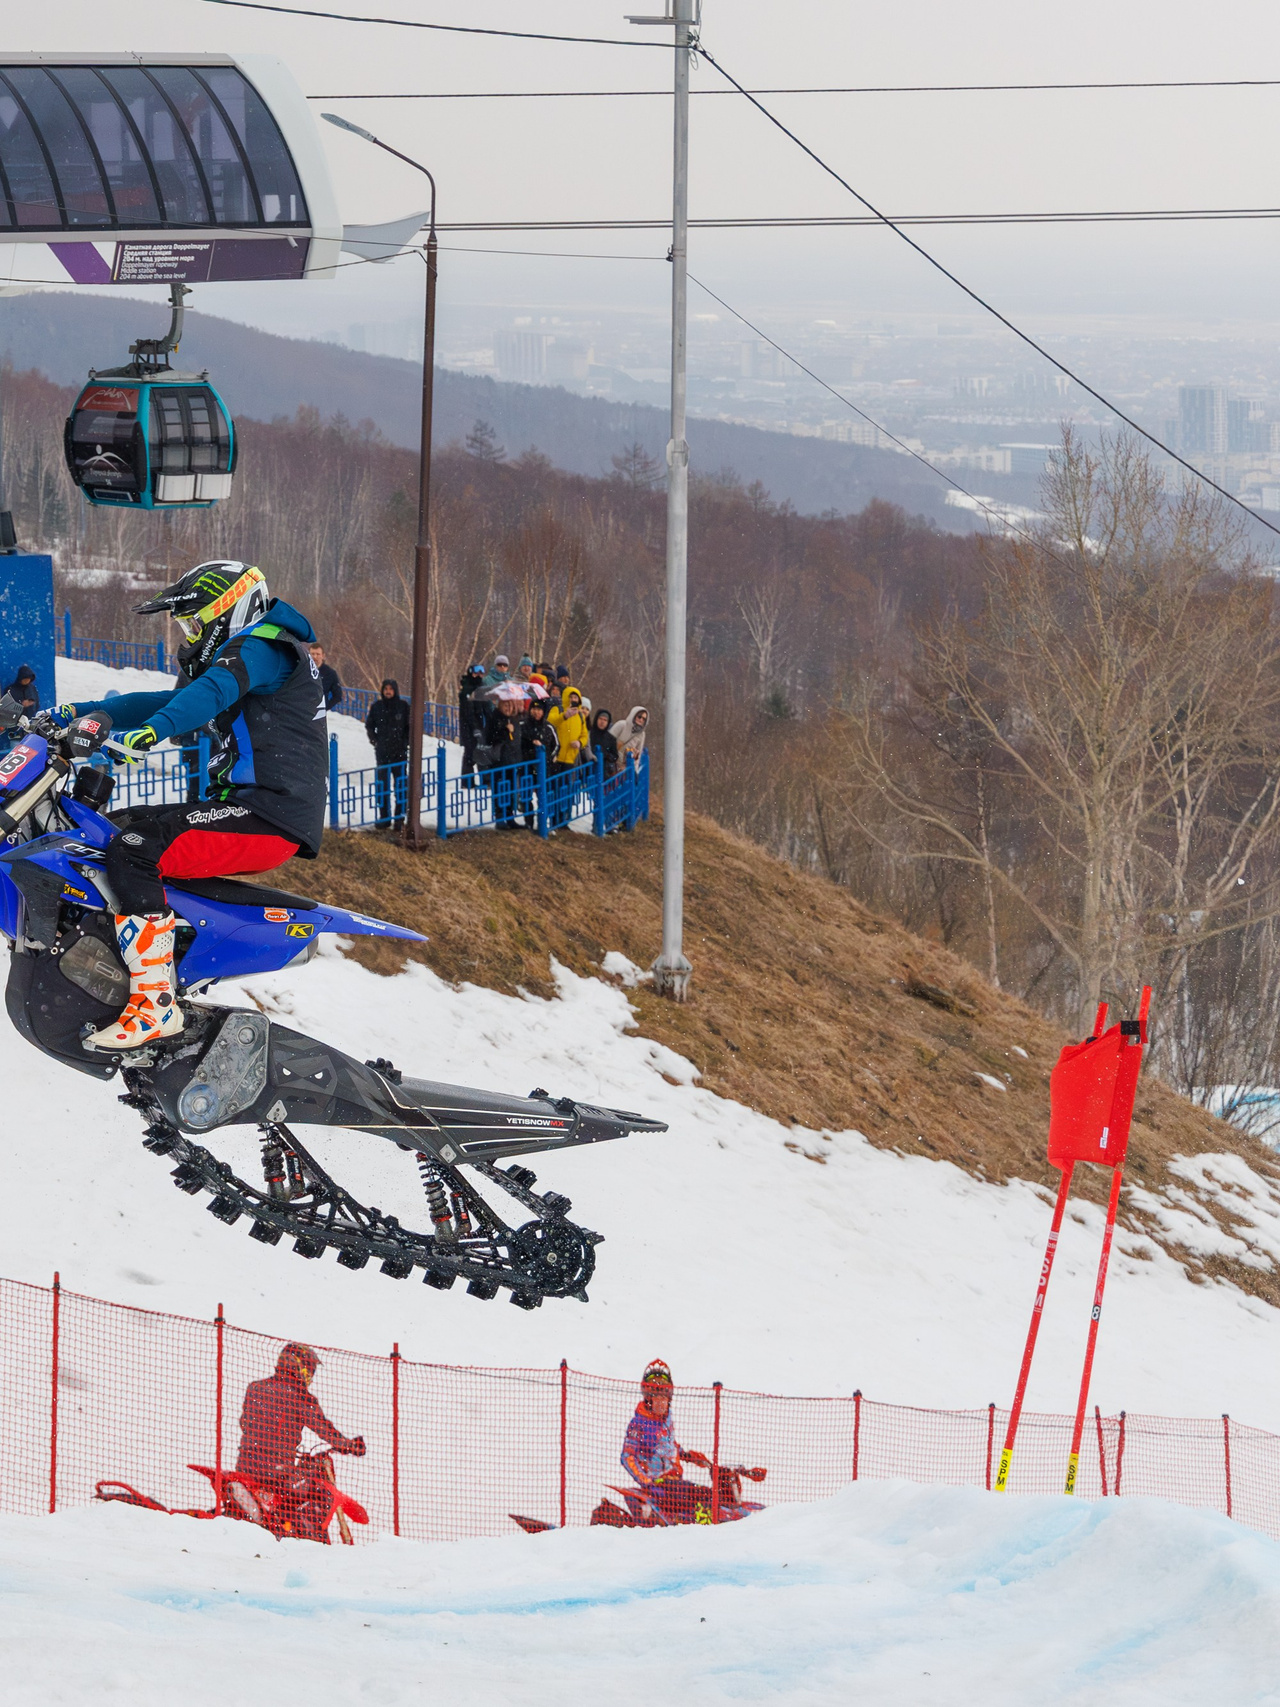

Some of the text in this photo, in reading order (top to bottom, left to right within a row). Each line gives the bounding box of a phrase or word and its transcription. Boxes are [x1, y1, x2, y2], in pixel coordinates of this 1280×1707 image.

[209, 569, 260, 617] 100%
[186, 810, 211, 824] Troy
[210, 806, 231, 821] Lee
[996, 1459, 1009, 1486] SPM
[1064, 1464, 1076, 1492] SPM
